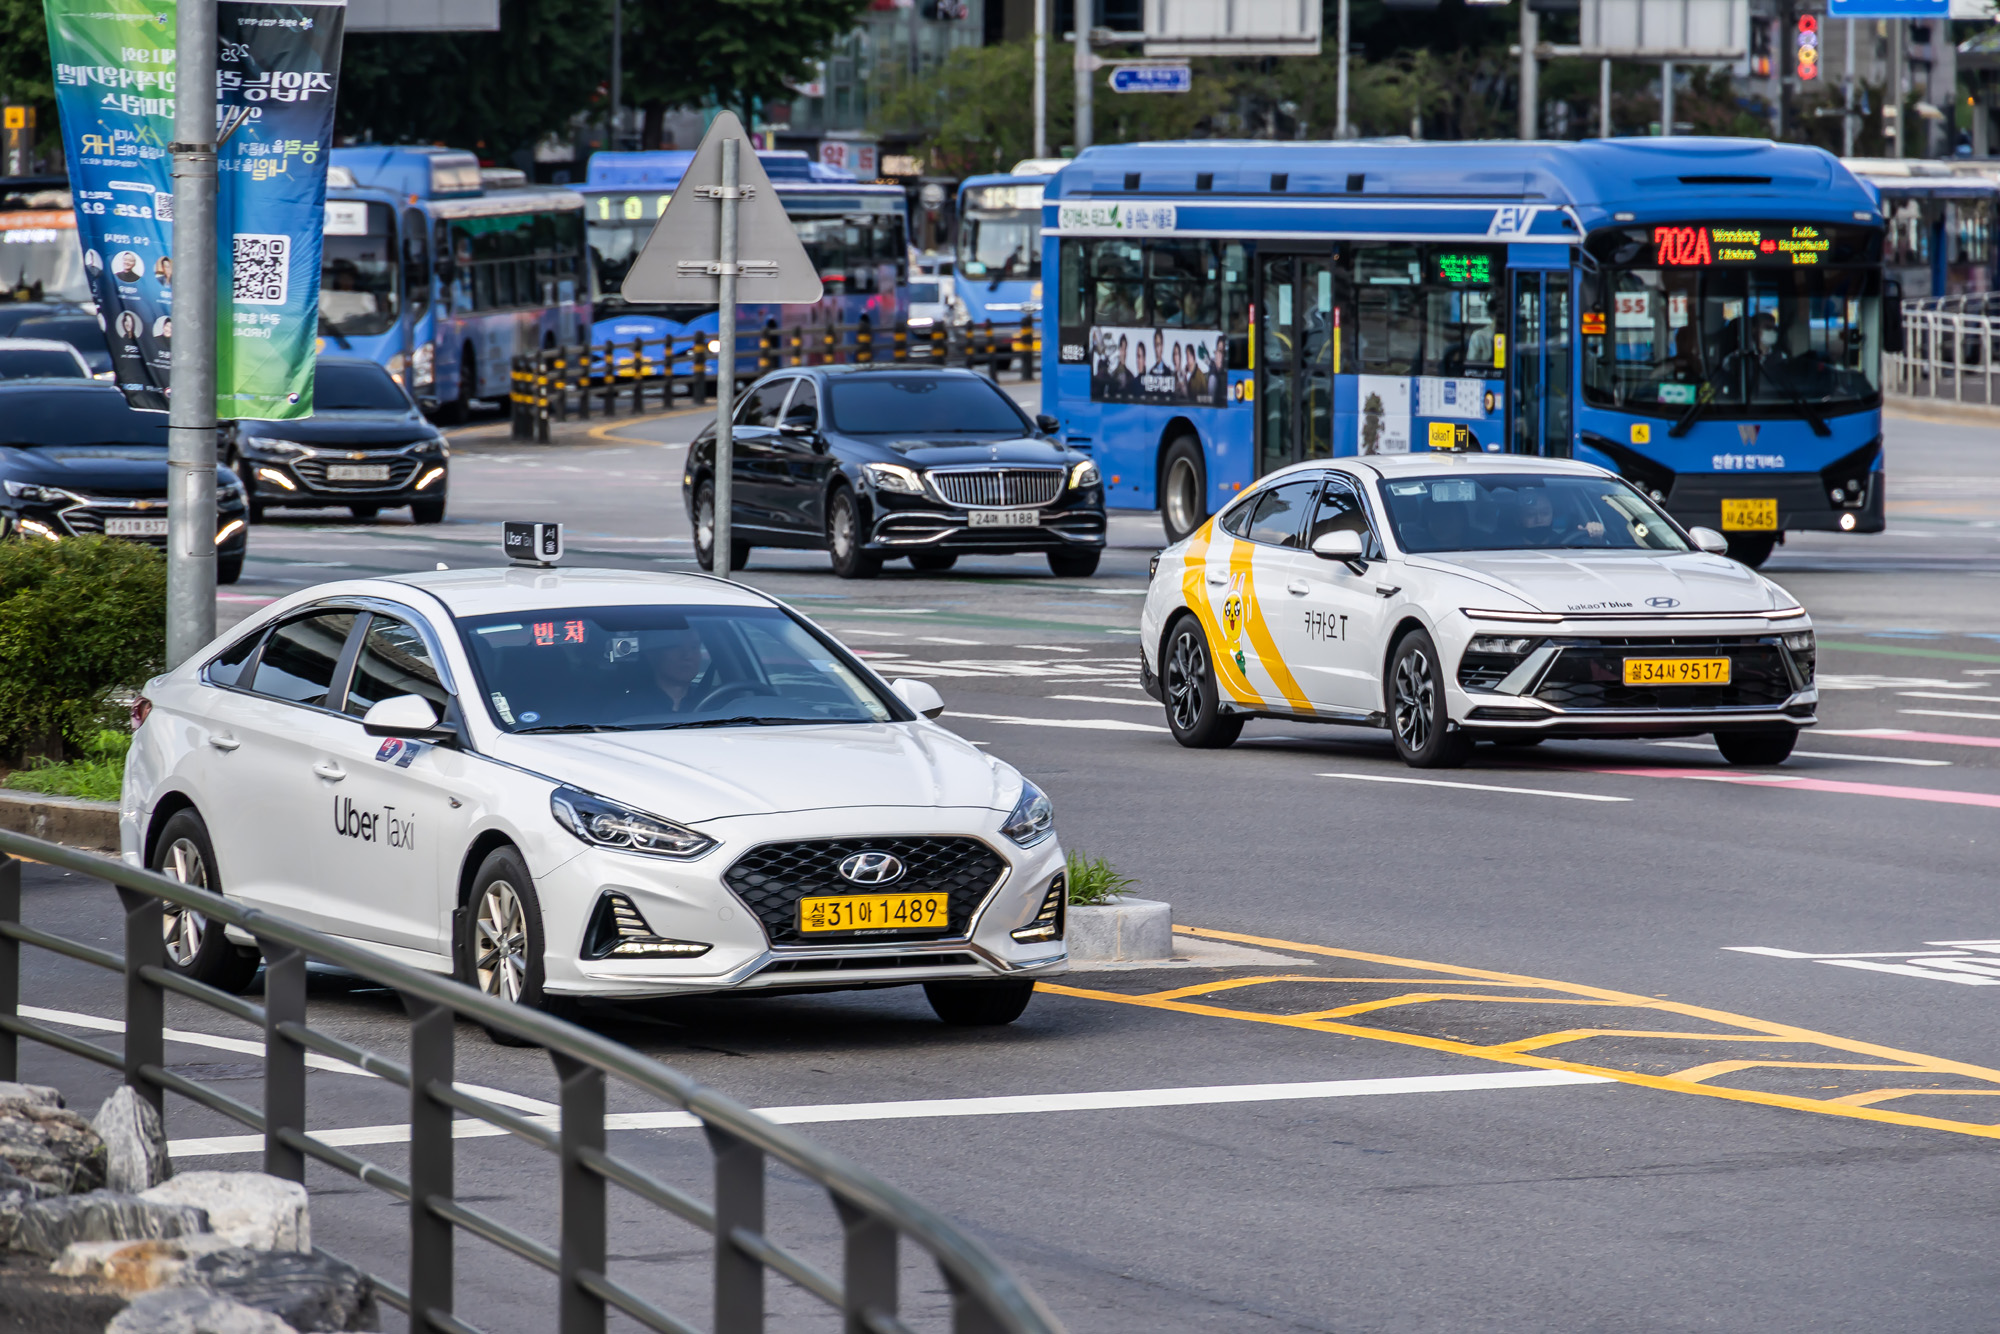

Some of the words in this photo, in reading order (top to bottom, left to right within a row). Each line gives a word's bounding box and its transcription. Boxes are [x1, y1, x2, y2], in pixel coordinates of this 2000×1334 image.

[1495, 208, 1530, 235] EV
[1655, 226, 1712, 265] 702A
[1737, 511, 1774, 527] 4545
[544, 528, 556, 553] 서울
[1608, 601, 1633, 609] blue
[533, 621, 555, 646] 빈
[563, 620, 586, 643] 차
[1643, 663, 1675, 680] 34사
[1679, 662, 1722, 680] 9517
[334, 795, 379, 842] Uber
[383, 805, 415, 850] Taxi
[811, 902, 825, 927] 서울
[828, 902, 872, 926] 31아
[879, 899, 938, 924] 1489
